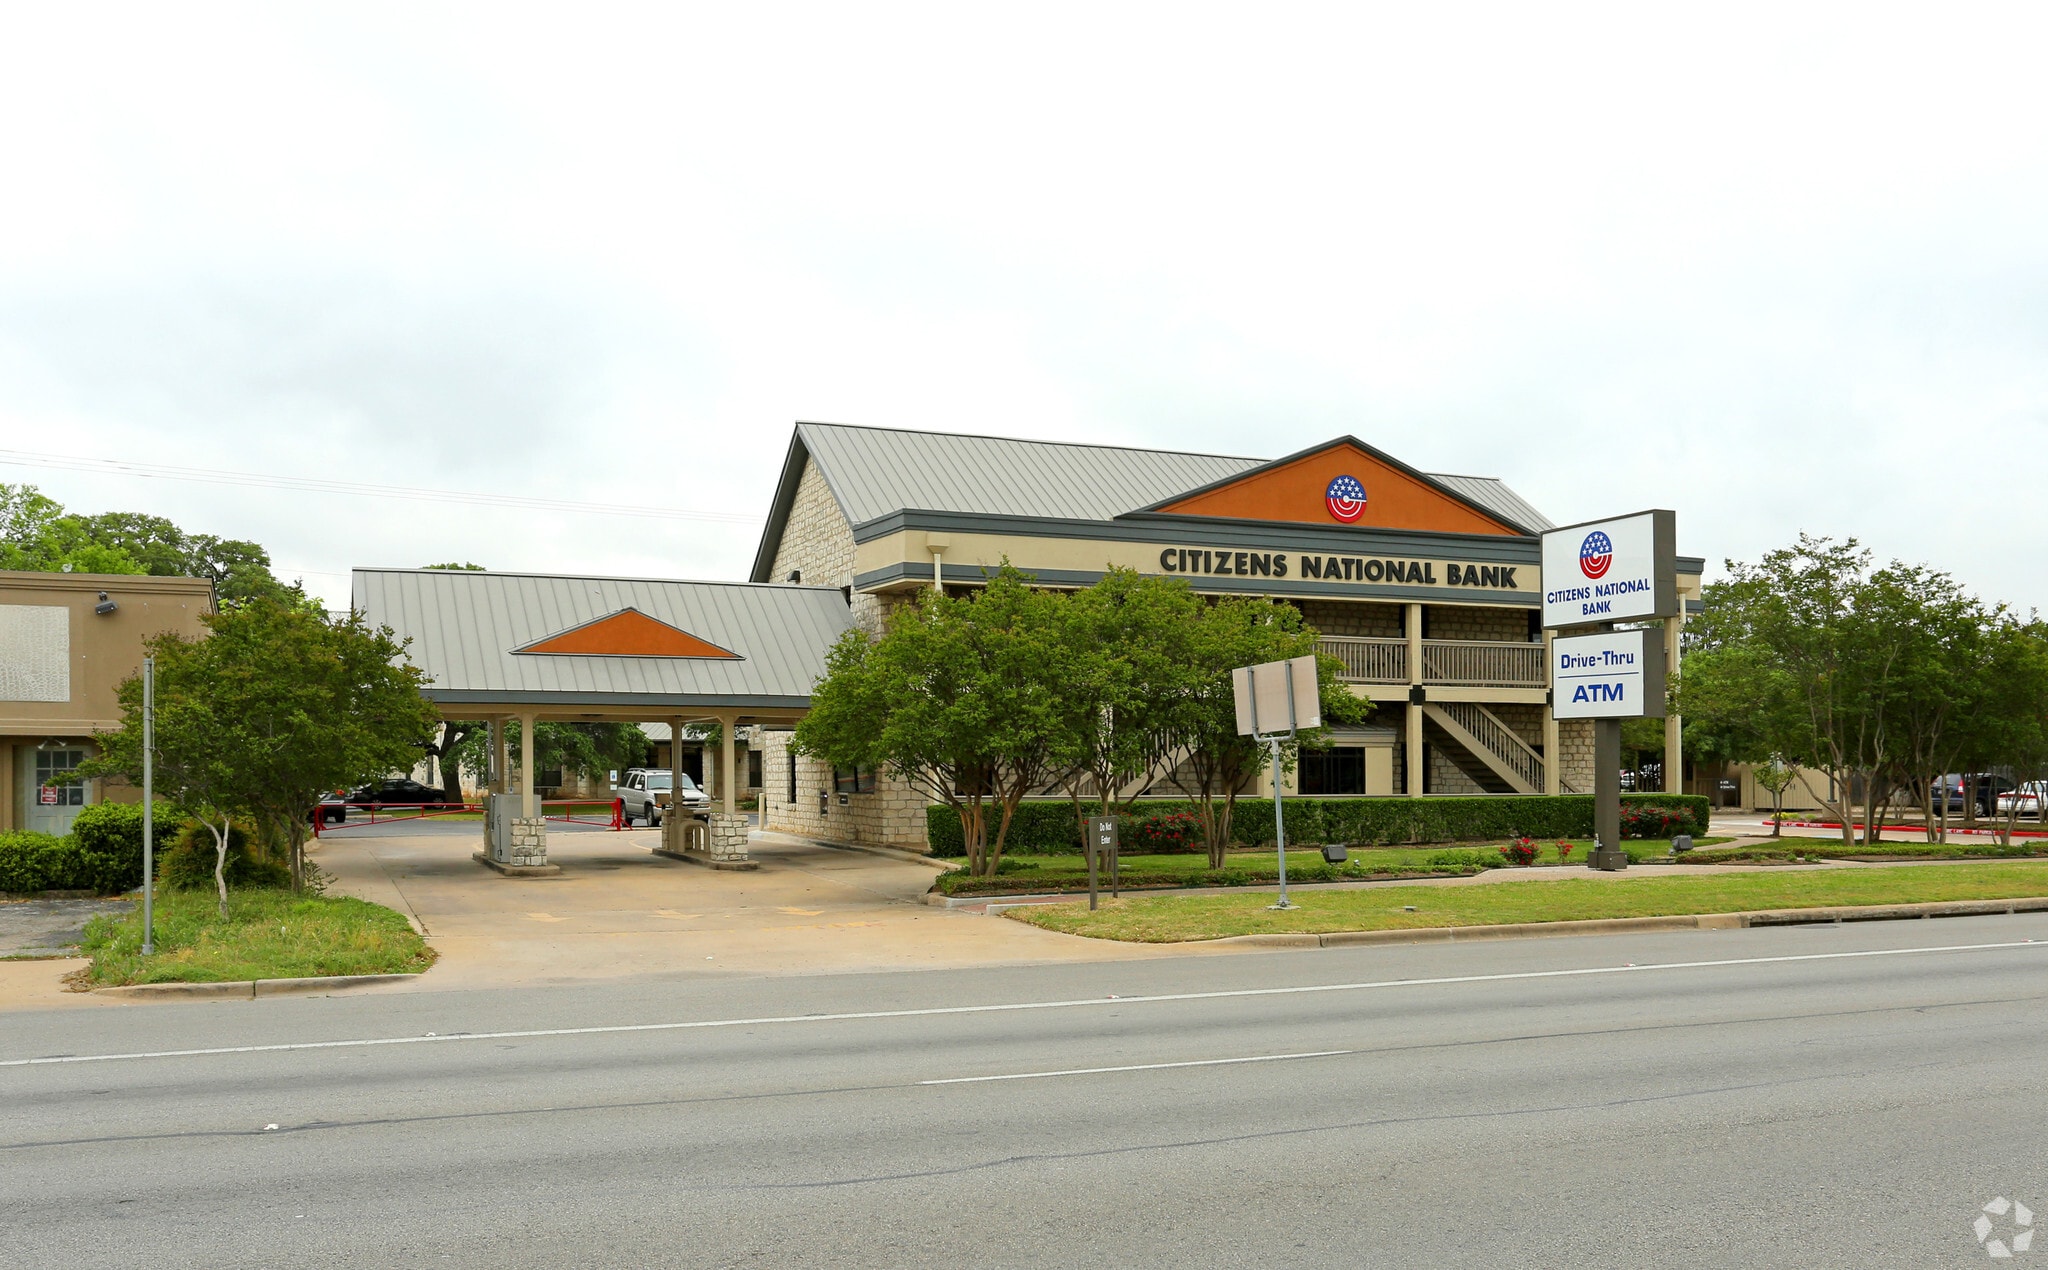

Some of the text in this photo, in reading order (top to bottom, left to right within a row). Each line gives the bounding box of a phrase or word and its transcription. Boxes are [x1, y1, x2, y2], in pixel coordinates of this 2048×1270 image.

[1160, 548, 1518, 589] CITIZENS NATIONAL BANK
[1547, 578, 1650, 604] CITIZENS NATIONAL
[1582, 600, 1611, 616] BANK
[1561, 650, 1634, 669] Drive-Thru
[1572, 683, 1623, 703] ATM
[1099, 822, 1105, 832] Do
[1101, 835, 1111, 845] Enter
